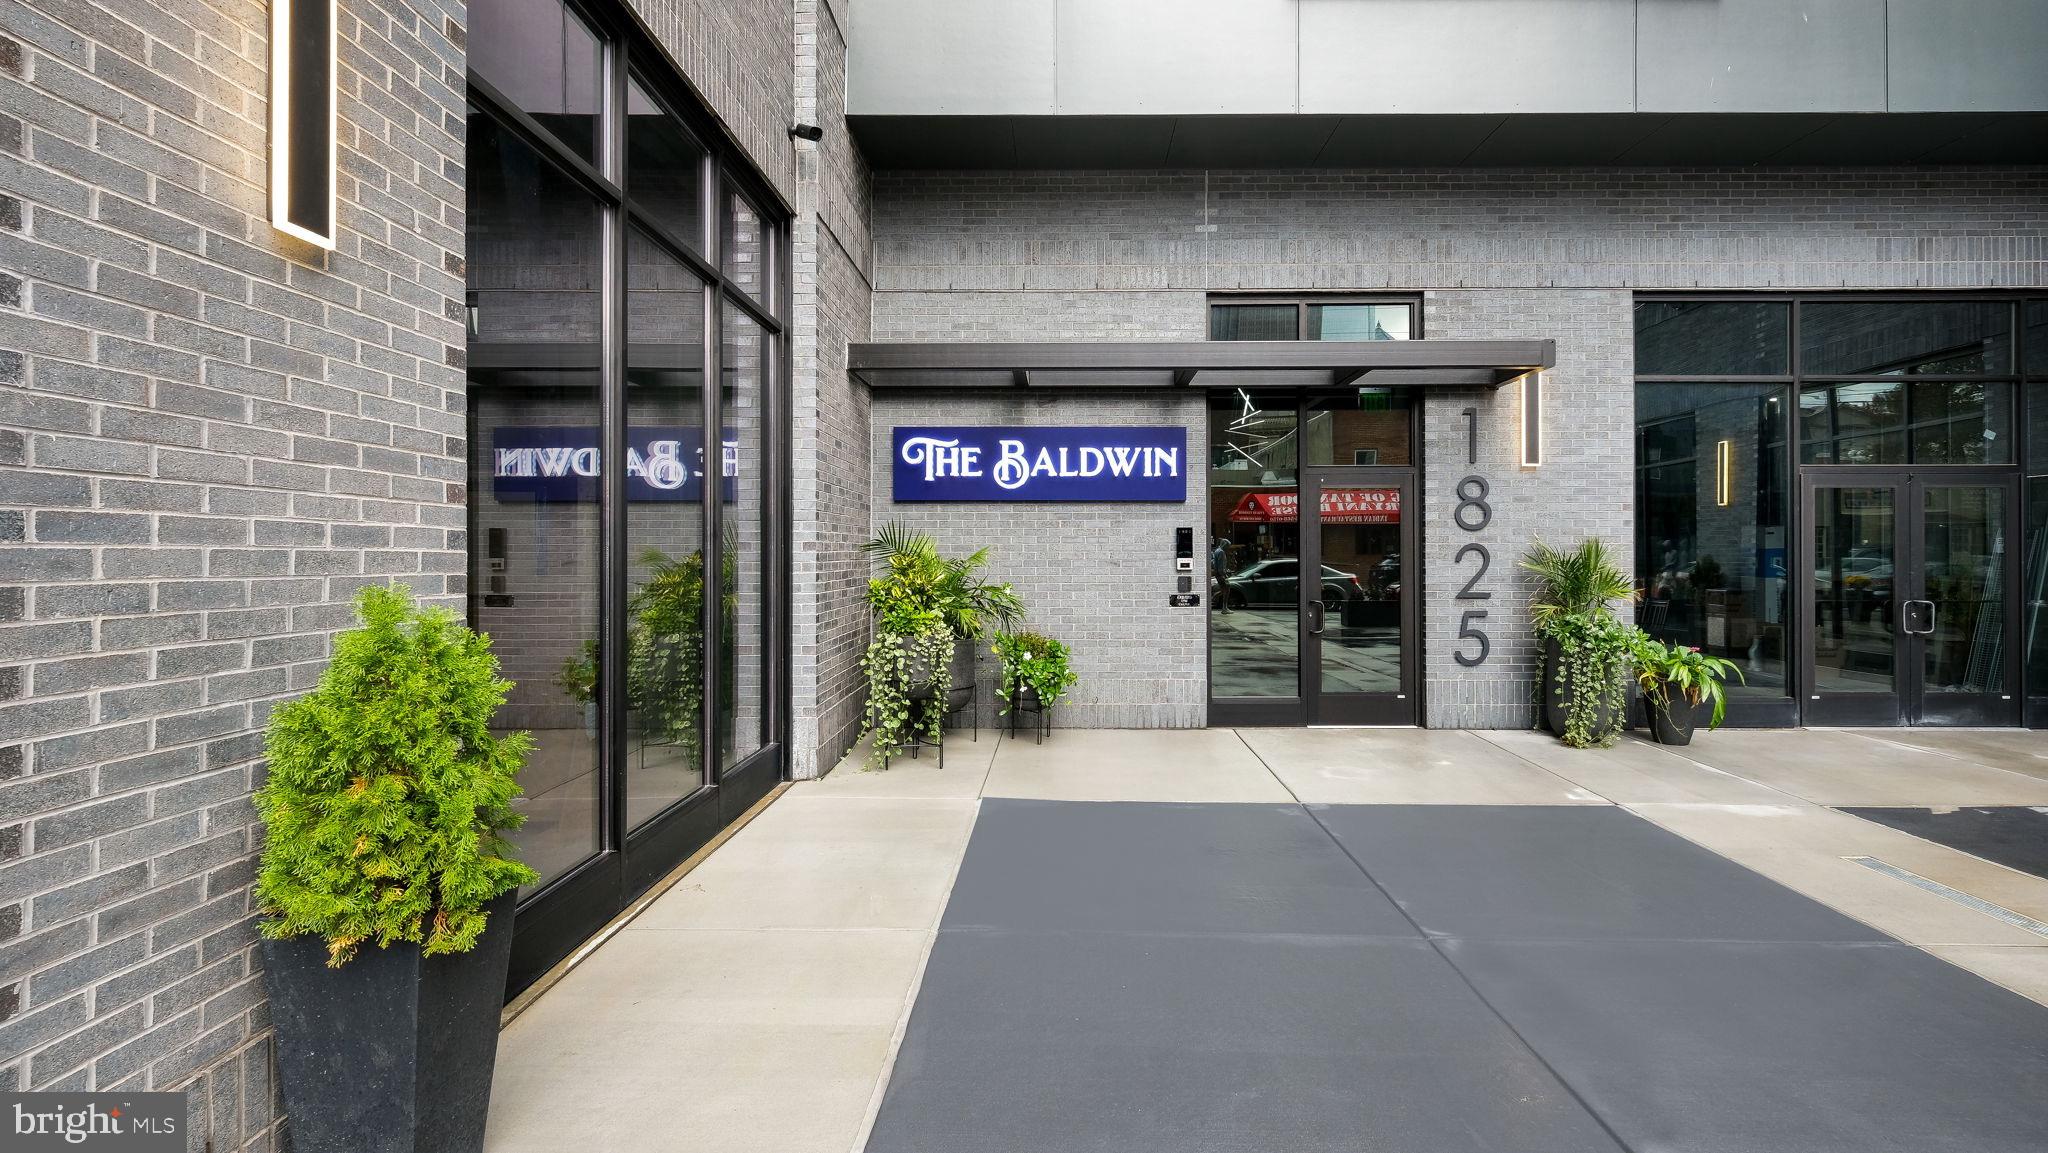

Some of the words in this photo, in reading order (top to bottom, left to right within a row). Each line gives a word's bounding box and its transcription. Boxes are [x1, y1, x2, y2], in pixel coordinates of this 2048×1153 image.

[902, 437, 982, 481] THE
[993, 440, 1178, 489] BALDWIN
[1454, 407, 1492, 667] 1825
